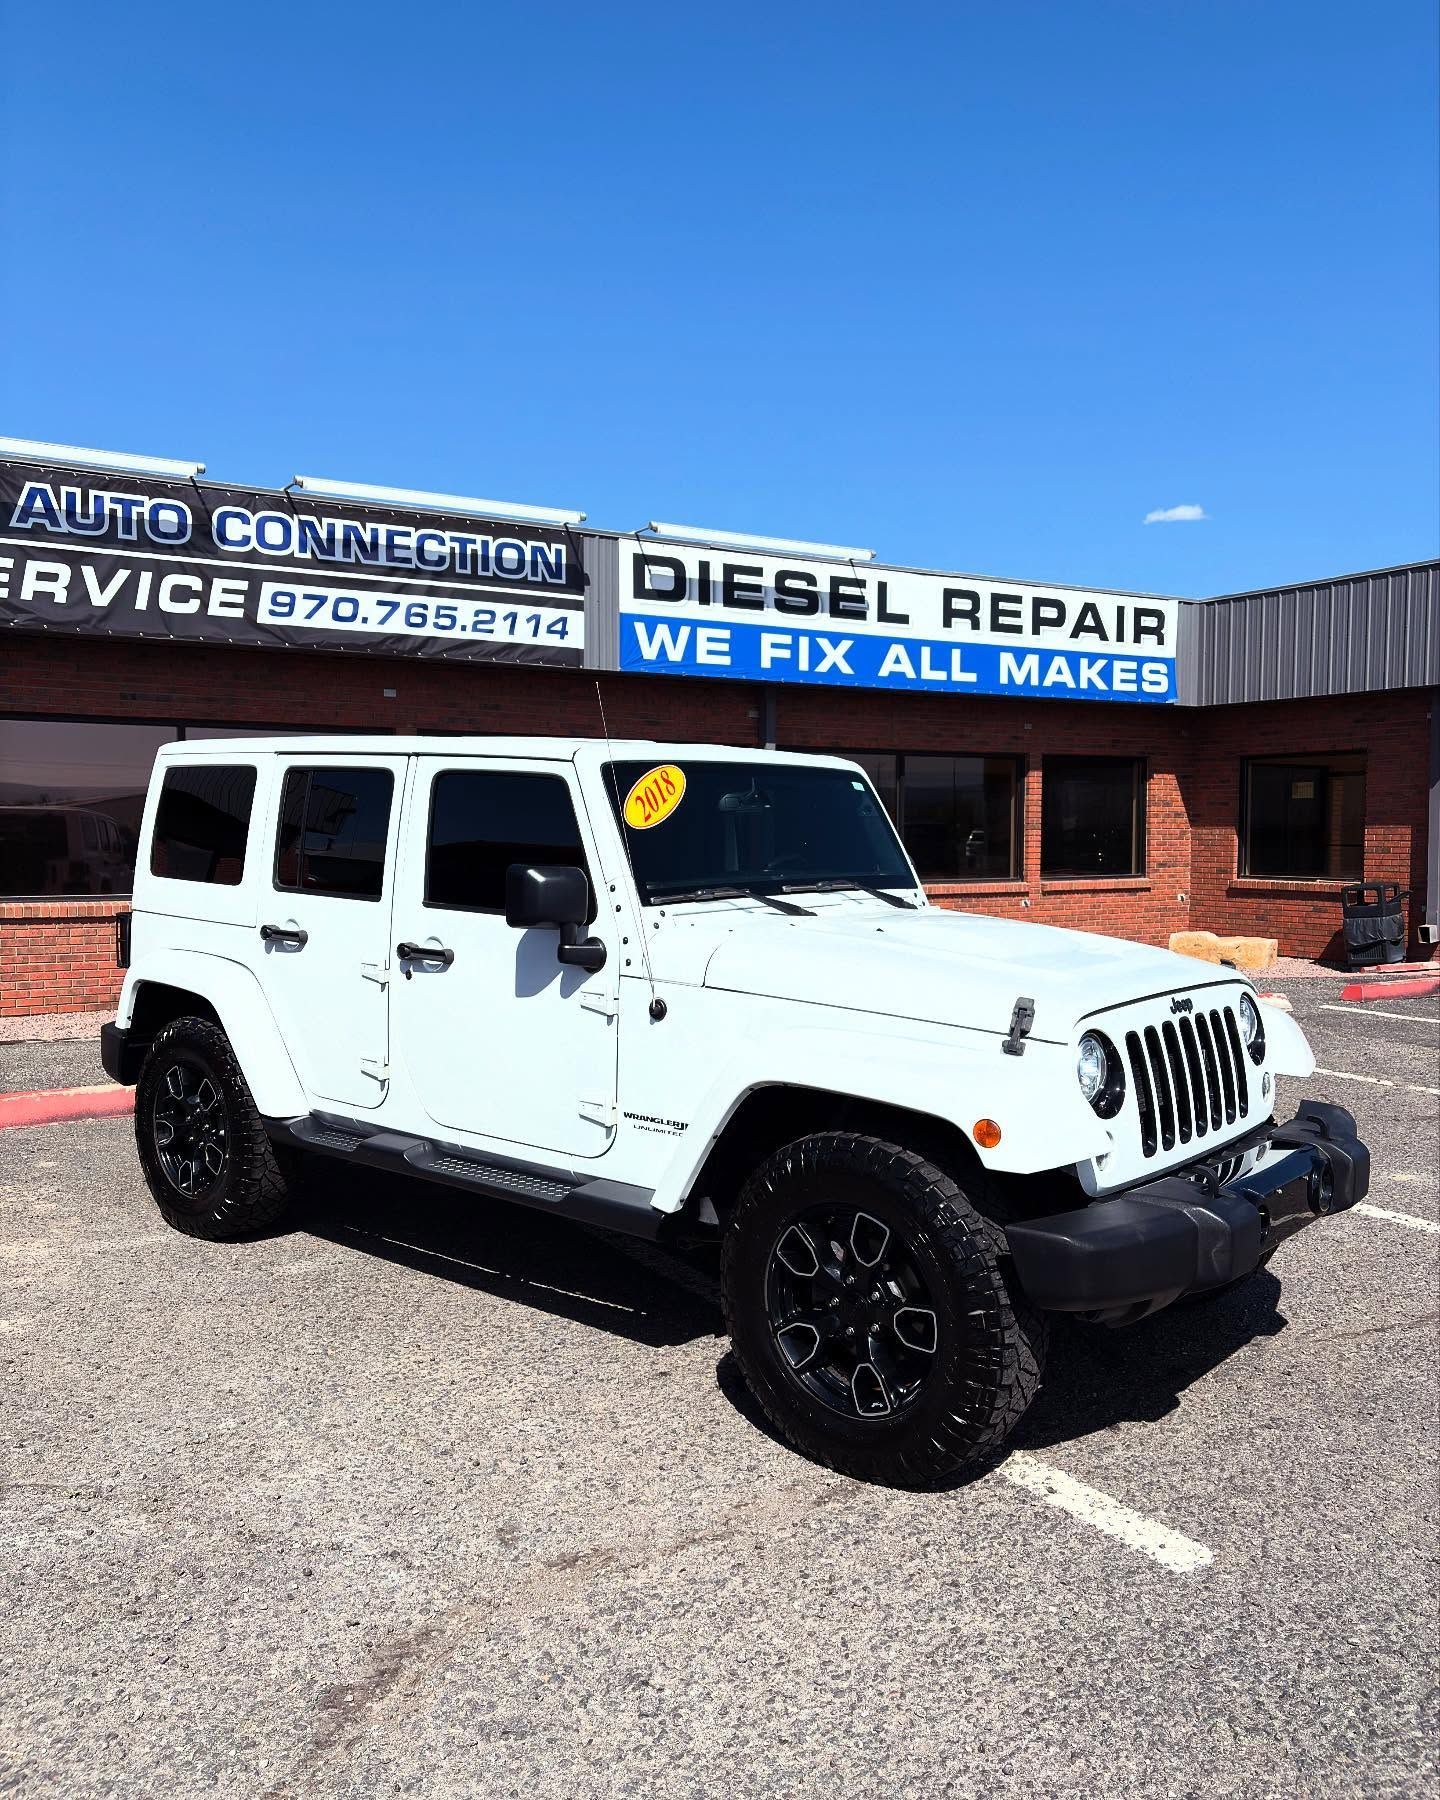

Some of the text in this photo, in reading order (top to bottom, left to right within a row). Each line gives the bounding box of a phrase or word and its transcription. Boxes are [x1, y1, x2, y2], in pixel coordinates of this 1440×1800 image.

[9, 481, 567, 584] AUTO CONNECTION
[267, 591, 570, 640] 970.765.2114
[633, 553, 1166, 646] DIESEL REPAIR
[633, 622, 1169, 693] WE FIX ALL MAKES
[634, 769, 677, 823] 2018
[1169, 996, 1194, 1015] Jeep
[623, 1111, 680, 1128] WRANGLER
[633, 1124, 684, 1138] UNLIMITED
